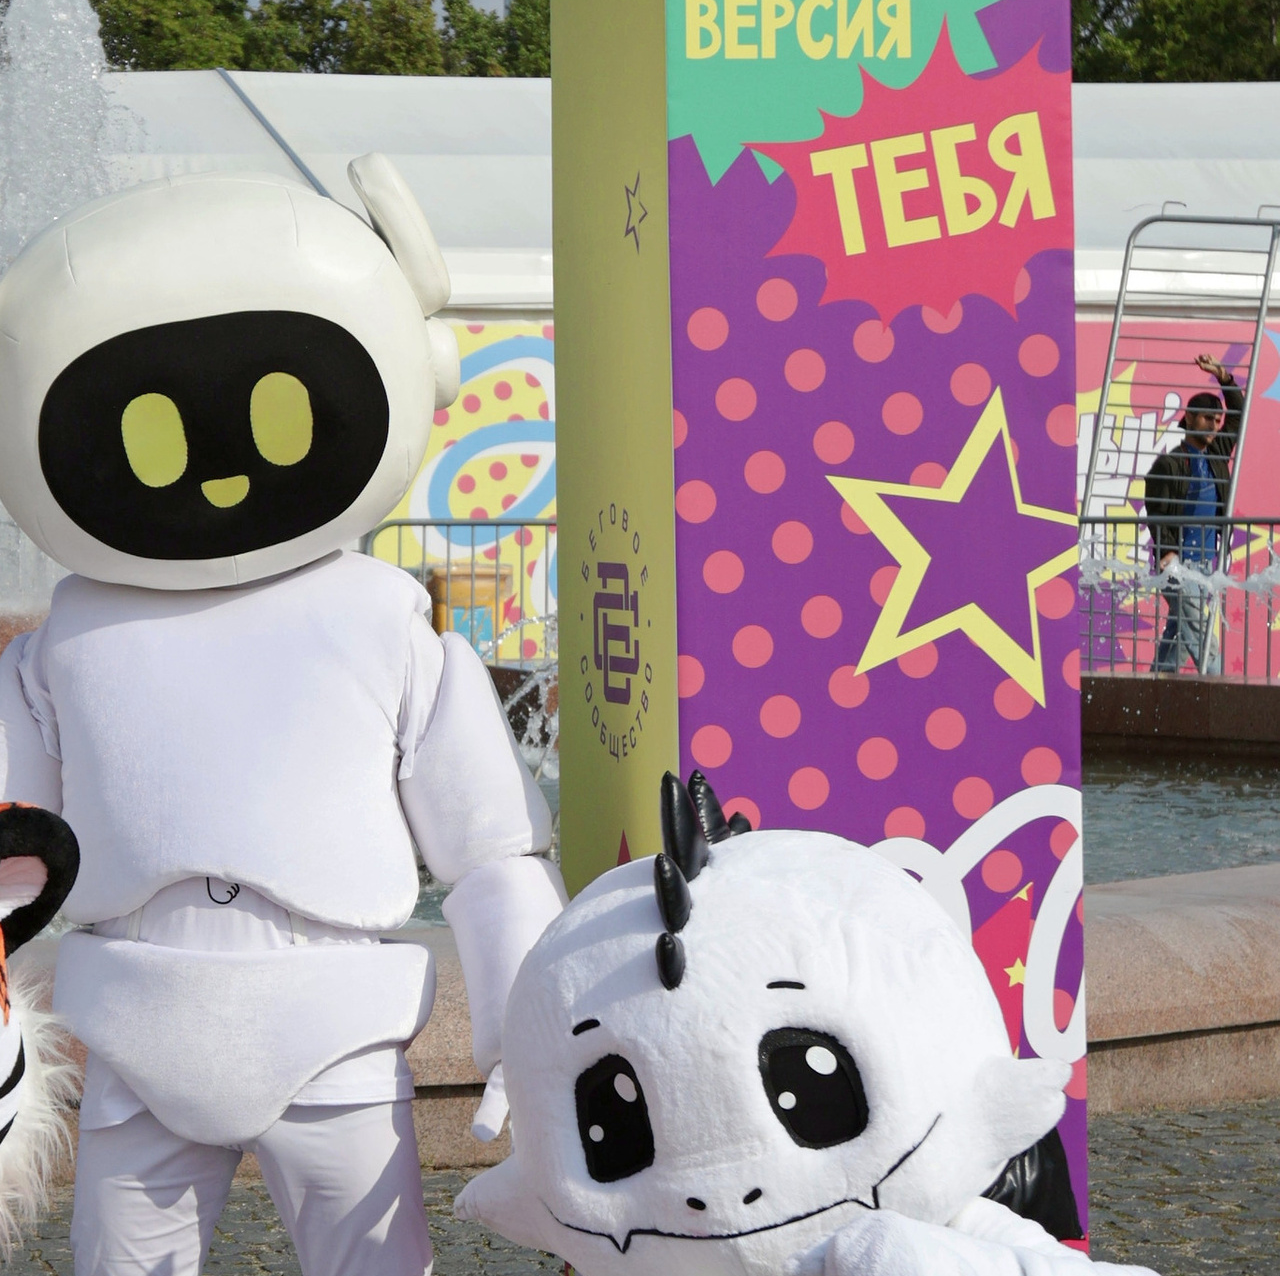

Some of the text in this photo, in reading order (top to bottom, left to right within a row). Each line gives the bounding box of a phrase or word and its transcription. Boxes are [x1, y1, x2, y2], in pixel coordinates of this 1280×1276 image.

[808, 110, 1057, 257] ТЕБЯ
[580, 502, 649, 587] БЕГОВОЕ
[579, 654, 653, 764] СООБЩЕСТВО
